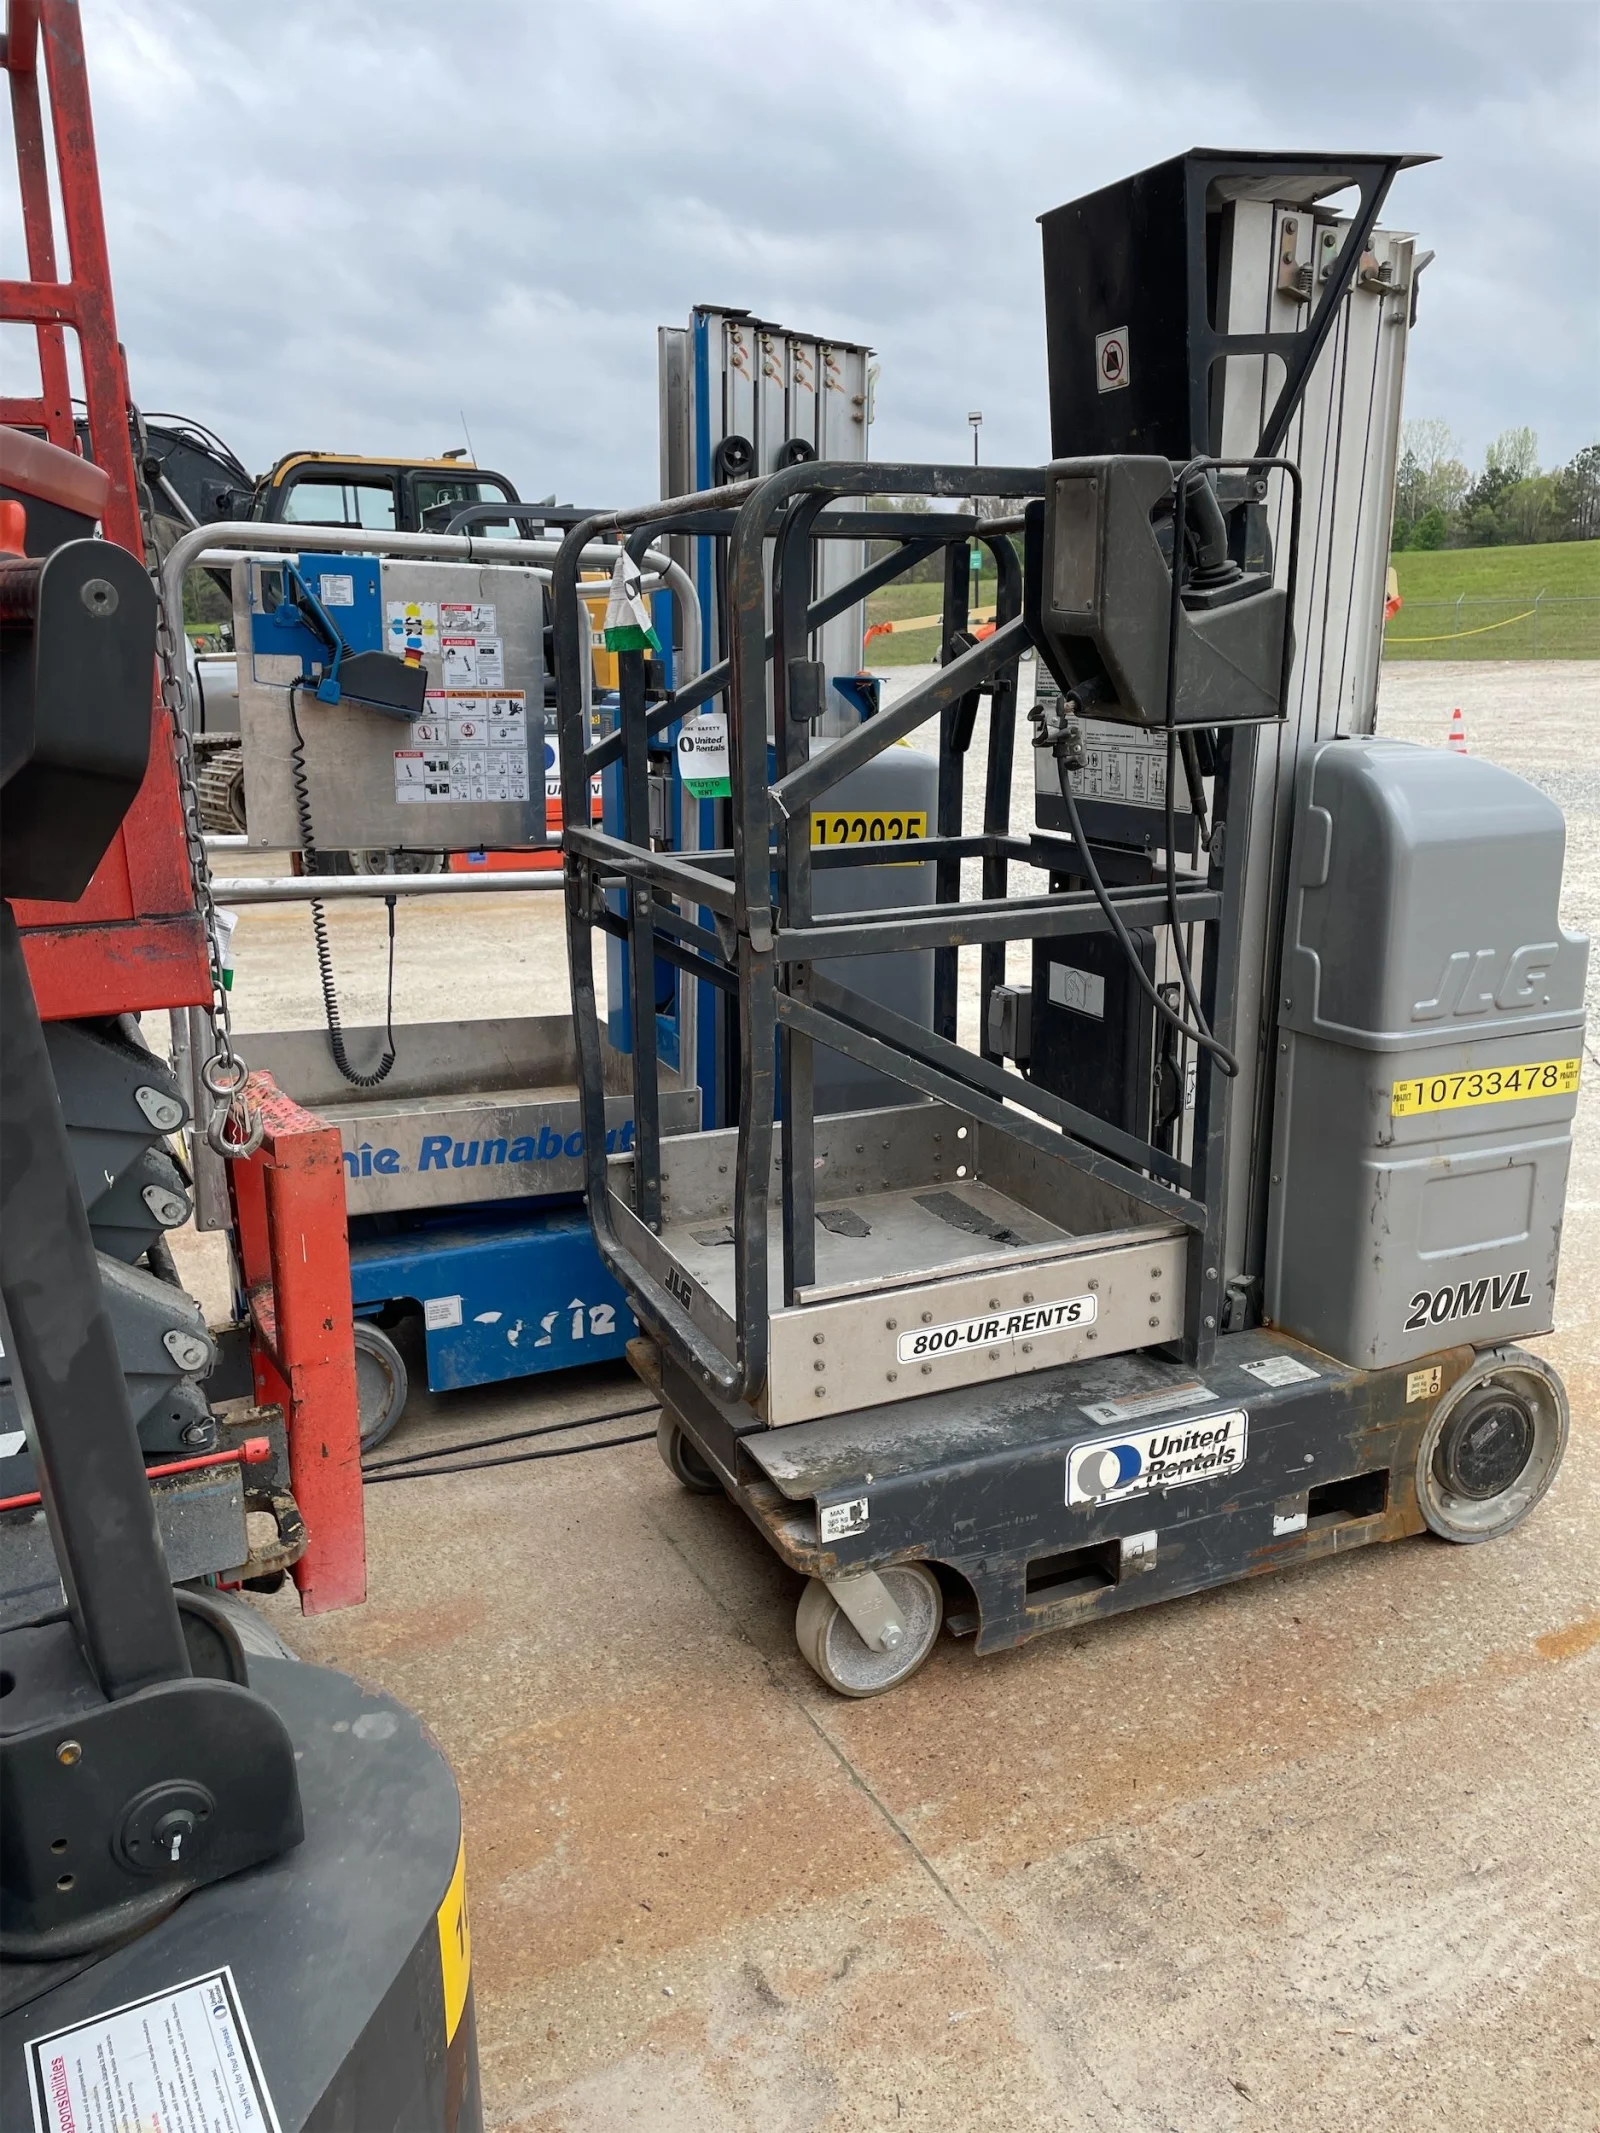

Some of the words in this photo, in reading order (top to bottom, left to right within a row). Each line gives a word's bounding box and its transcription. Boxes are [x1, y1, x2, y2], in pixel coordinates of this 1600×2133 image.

[695, 736, 723, 744] United
[695, 744, 726, 753] Rentals
[1414, 1065, 1558, 1105] 10733478
[664, 1265, 694, 1311] JLG
[1404, 1270, 1532, 1332] 20MVL
[913, 1302, 1082, 1355] 800-UR-RENTS
[1247, 1362, 1266, 1370] JLG
[1149, 1421, 1232, 1459] United
[1146, 1446, 1237, 1484] Rentals
[830, 1508, 845, 1517] MAX
[220, 2027, 235, 2058] Business!
[230, 2058, 239, 2074] Your
[238, 2083, 247, 2098] You
[241, 2097, 253, 2119] Thank
